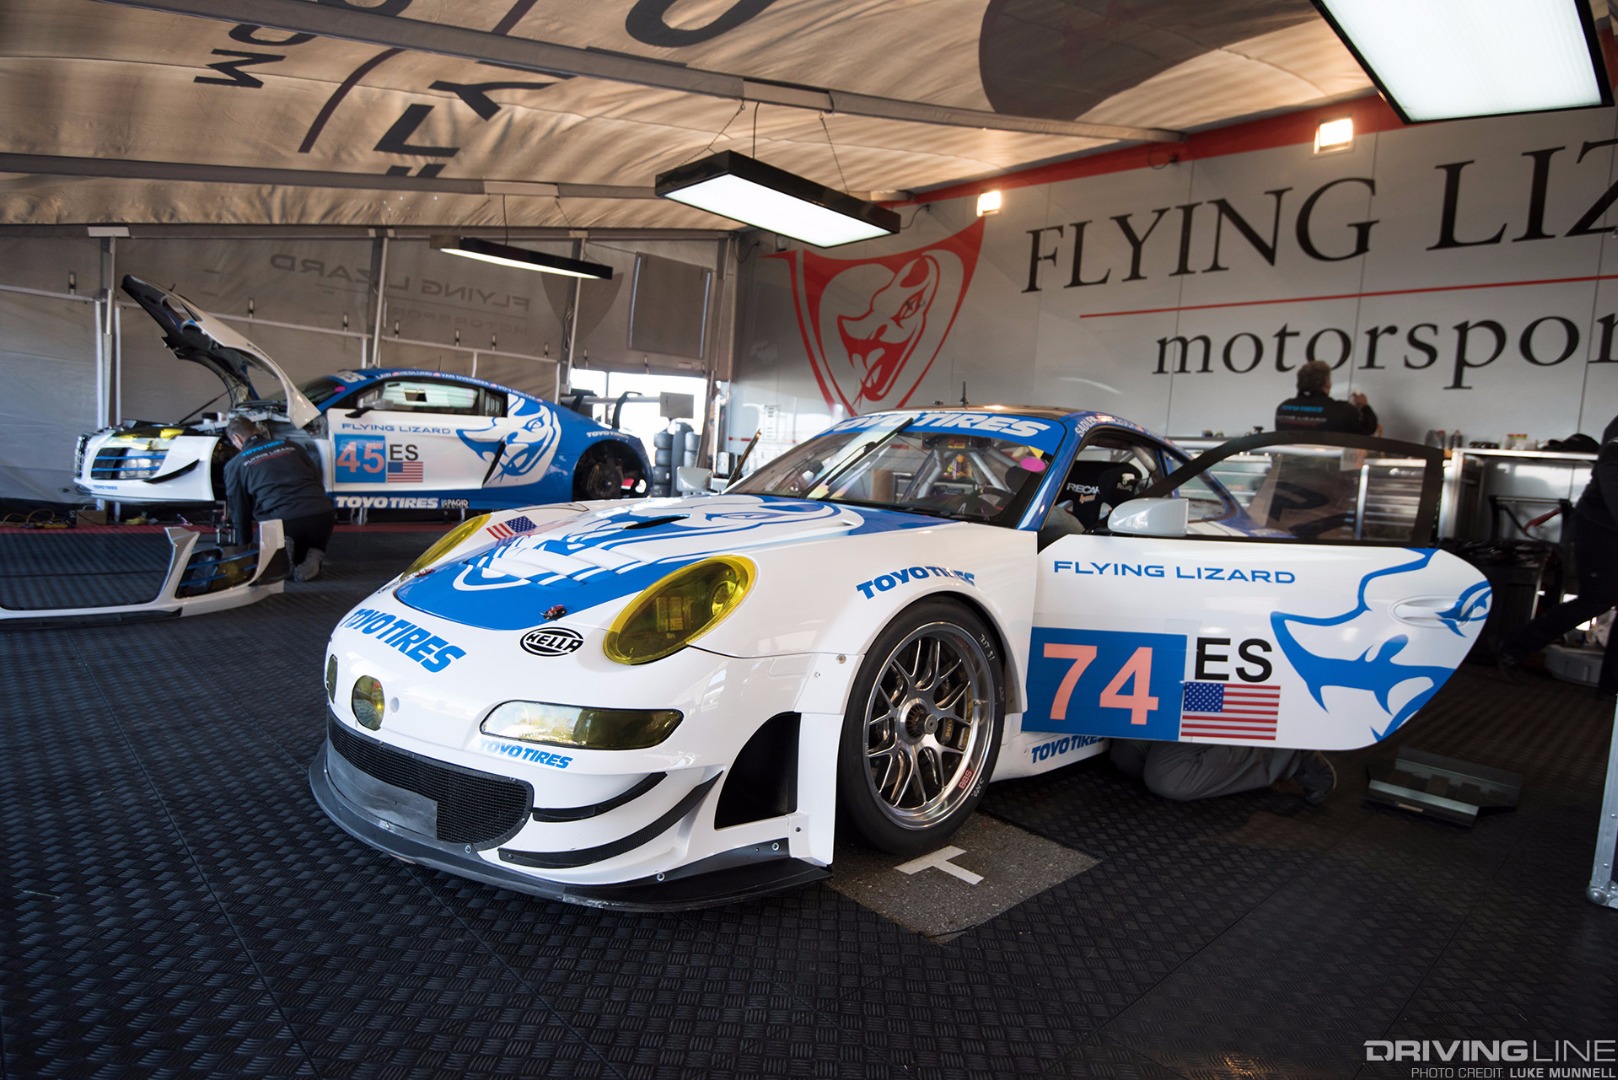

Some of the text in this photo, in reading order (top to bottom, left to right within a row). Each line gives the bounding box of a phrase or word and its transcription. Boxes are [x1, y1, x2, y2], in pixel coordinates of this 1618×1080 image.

[1021, 176, 1380, 293] FLYING
[342, 422, 451, 434] FLYING LIZARD
[833, 413, 1050, 437] OYO TIRES
[336, 441, 384, 473] 45
[389, 444, 419, 461] ES
[335, 496, 439, 508] TOYO TIRES
[856, 566, 930, 600] TOYO
[1054, 561, 1296, 584] FLYING LIZARD
[339, 608, 467, 673] TOYO TIRES
[526, 633, 584, 653] HELLA
[1194, 637, 1273, 683] ES
[1043, 642, 1159, 725] 74
[480, 738, 574, 769] TOYO TIRES
[1031, 740, 1067, 763] TOYO
[958, 769, 973, 789] BBS
